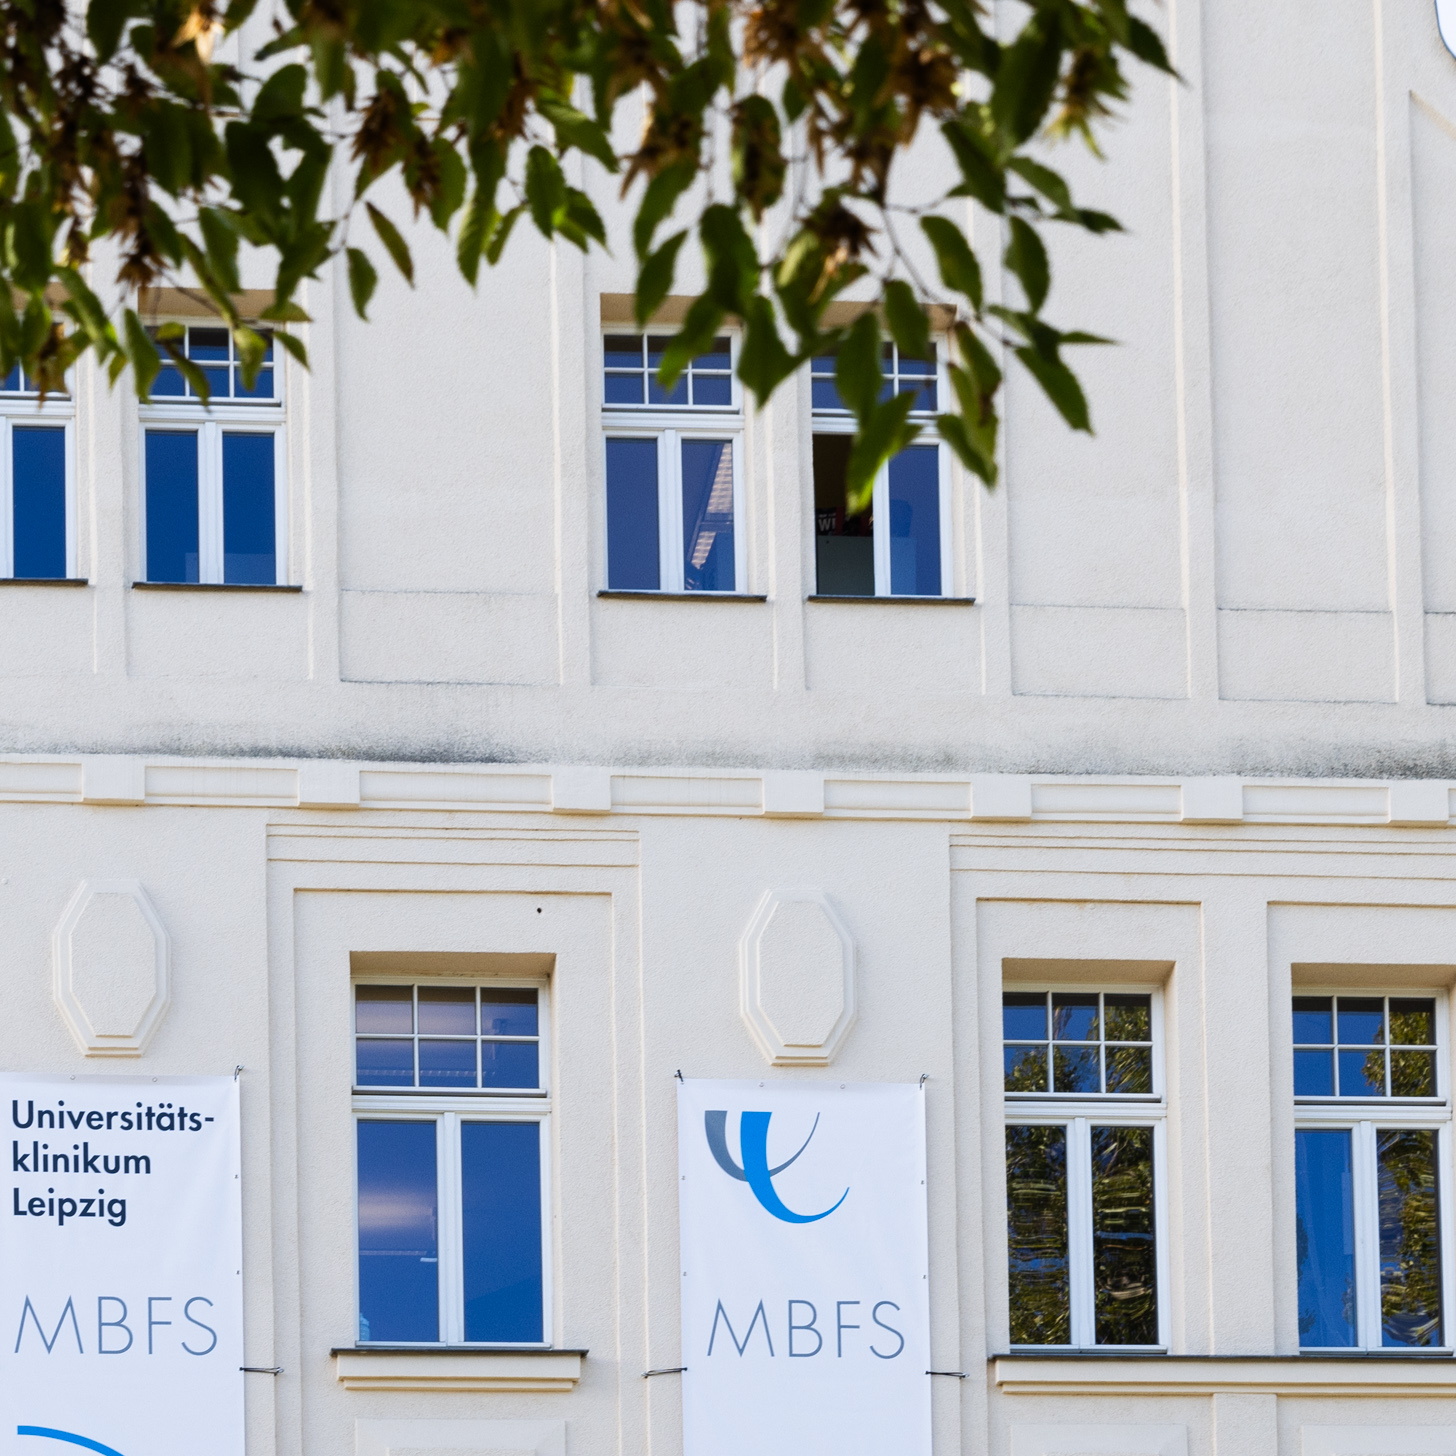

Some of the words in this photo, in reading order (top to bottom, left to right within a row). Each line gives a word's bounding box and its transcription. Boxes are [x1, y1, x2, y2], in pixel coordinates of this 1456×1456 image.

[11, 1099, 215, 1132] Universitäts-
[12, 1139, 152, 1175] klinikum
[12, 1187, 127, 1227] Leipzig
[14, 1294, 218, 1357] MBFS
[706, 1298, 905, 1360] MBFS
